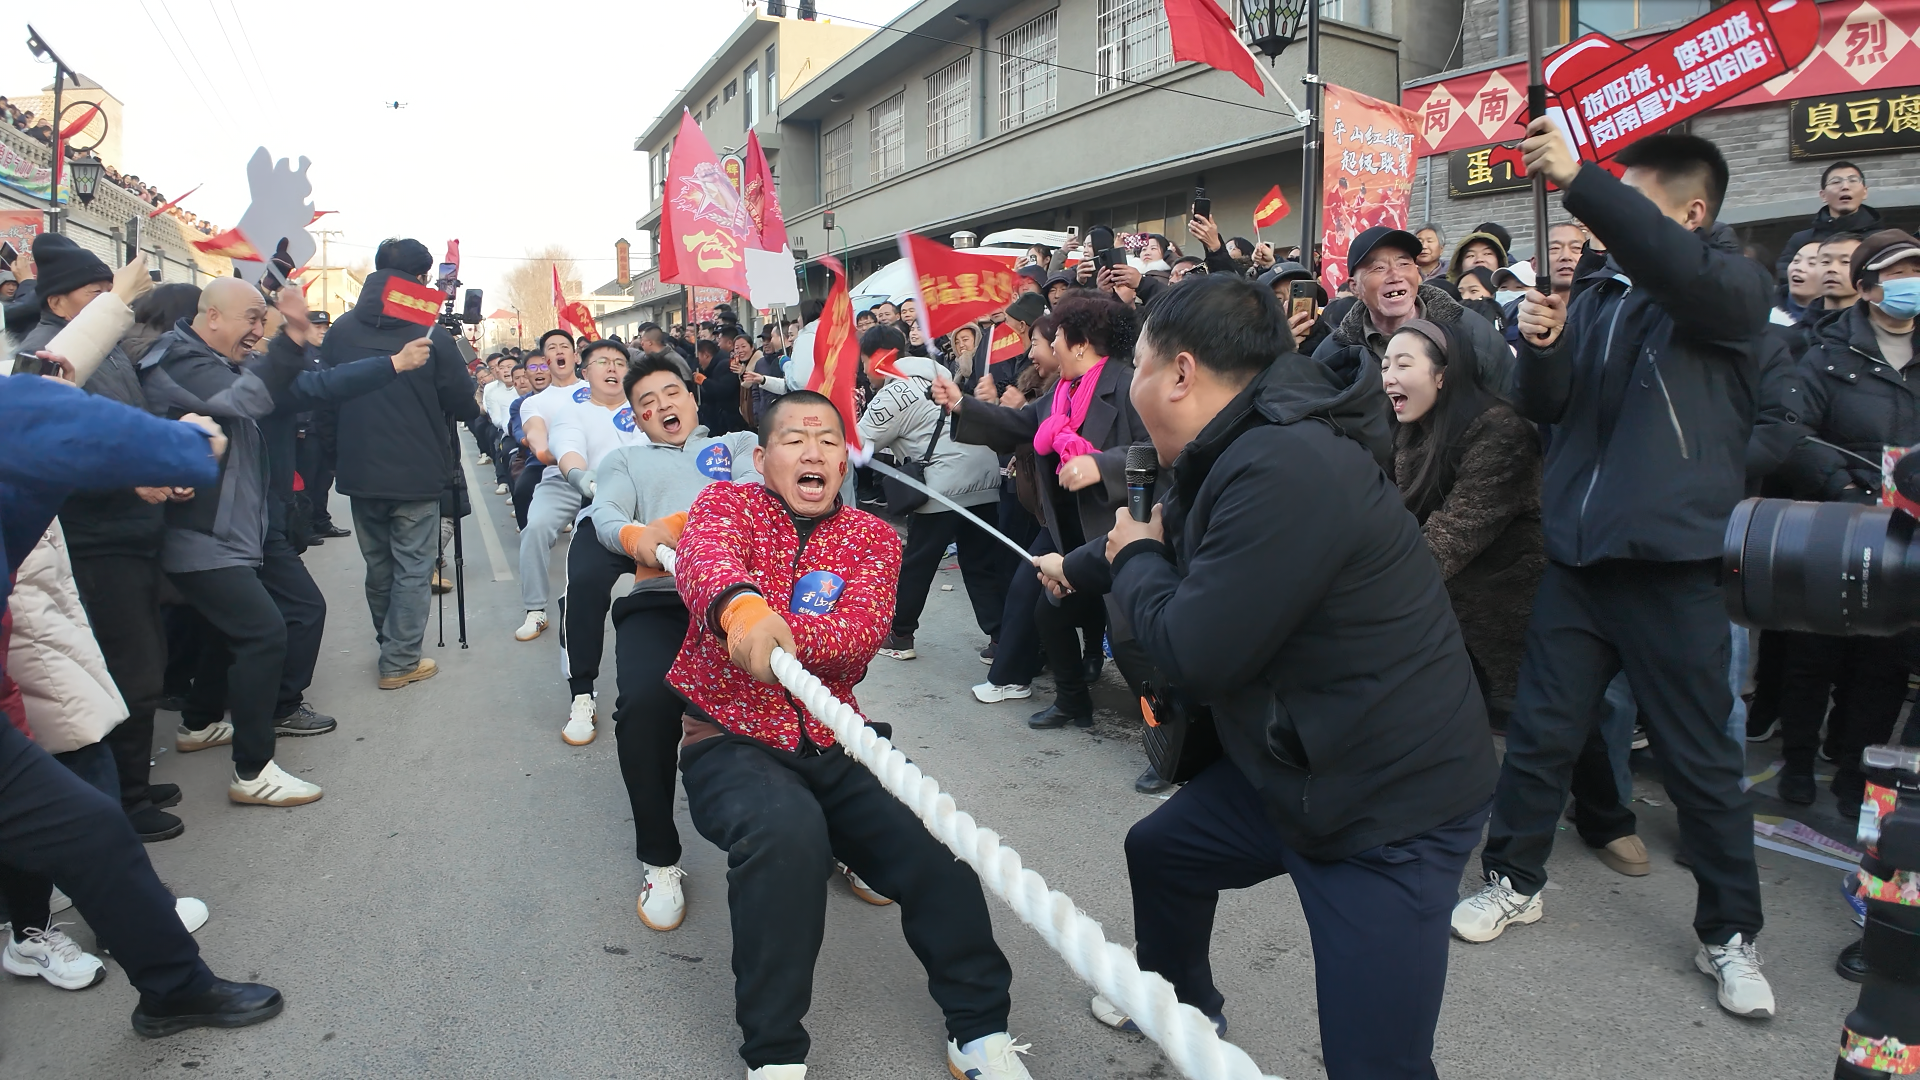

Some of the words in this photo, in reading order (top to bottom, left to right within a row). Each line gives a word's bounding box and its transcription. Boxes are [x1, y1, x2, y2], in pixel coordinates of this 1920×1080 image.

[1580, 63, 1664, 121] 拔呀拔，
[1673, 10, 1765, 71] 使劲拔，
[1589, 38, 1776, 149] 岗南星火笑哈哈！
[1805, 94, 1920, 142] 臭豆腐
[1467, 146, 1512, 186] 蛋
